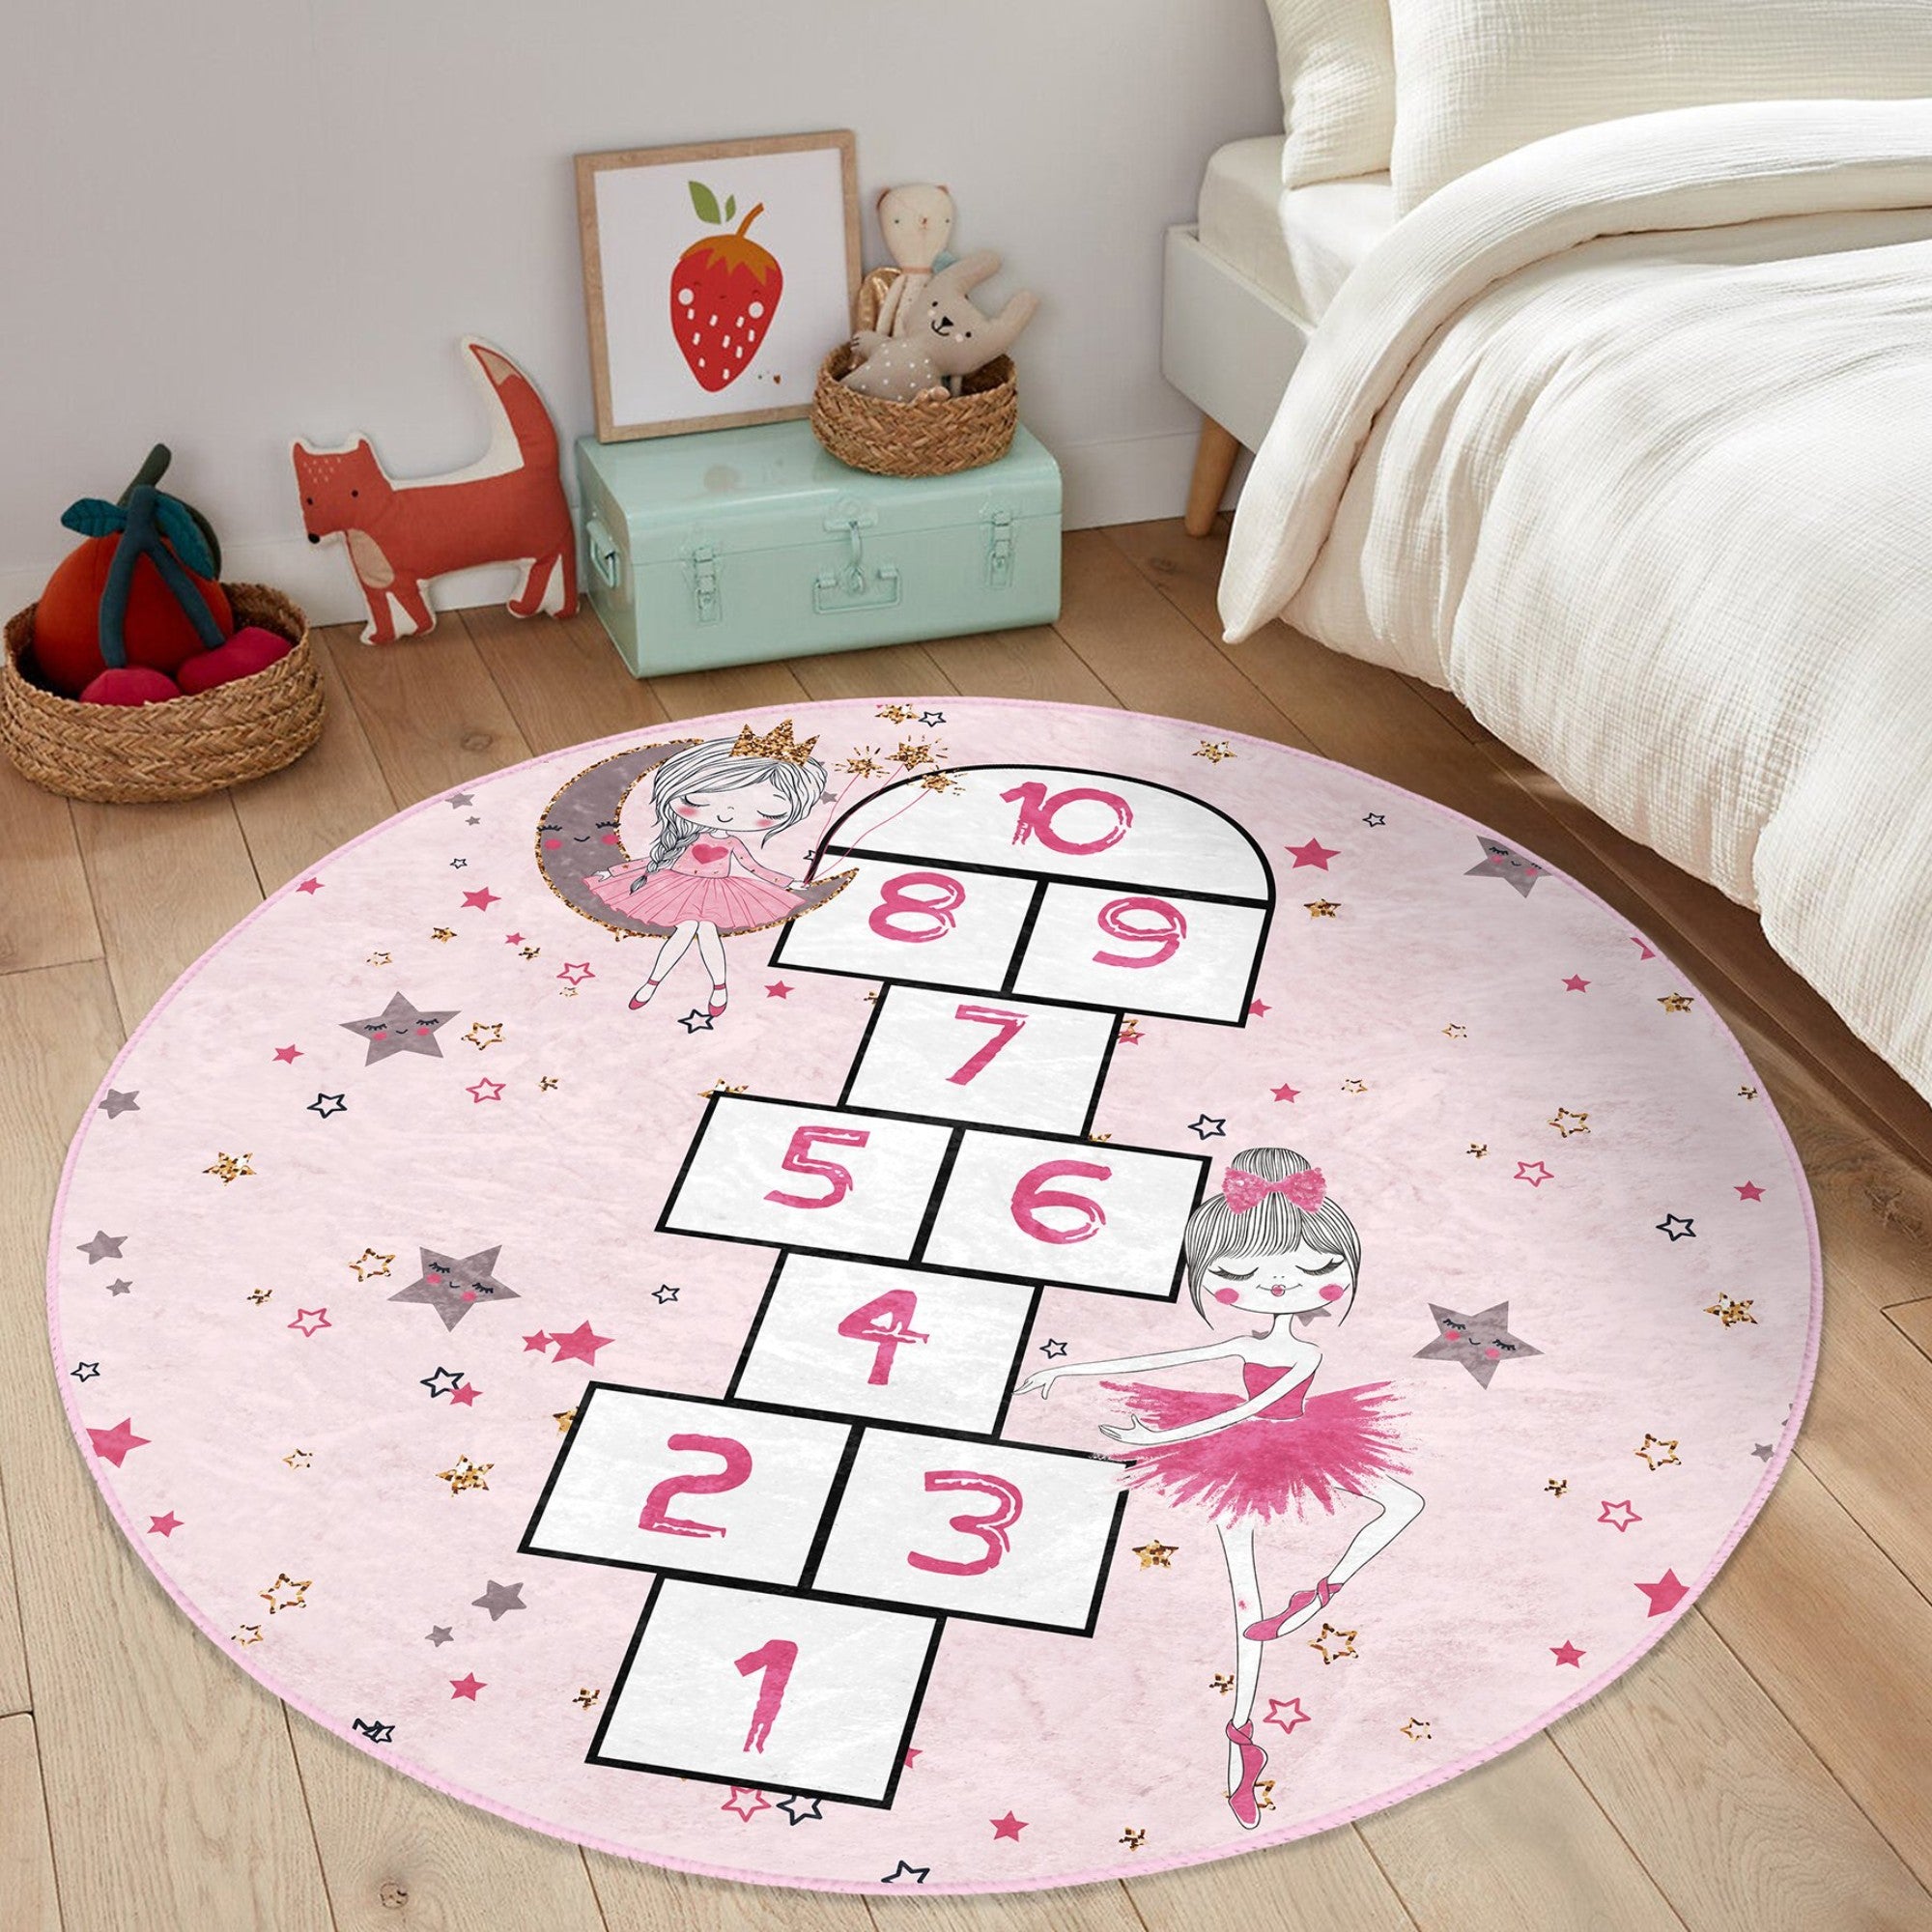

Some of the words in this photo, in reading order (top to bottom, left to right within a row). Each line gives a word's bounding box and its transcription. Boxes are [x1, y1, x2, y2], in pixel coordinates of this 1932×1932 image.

[1000, 781, 1134, 856] 10
[868, 872, 966, 944] 8
[1093, 897, 1187, 968] 9
[946, 1005, 1028, 1086] 7
[764, 1126, 870, 1209] 5
[1010, 1160, 1113, 1244] 6
[838, 1290, 929, 1386] 4
[639, 1434, 753, 1539] 2
[908, 1470, 1024, 1577] 3
[734, 1639, 799, 1754] 1
